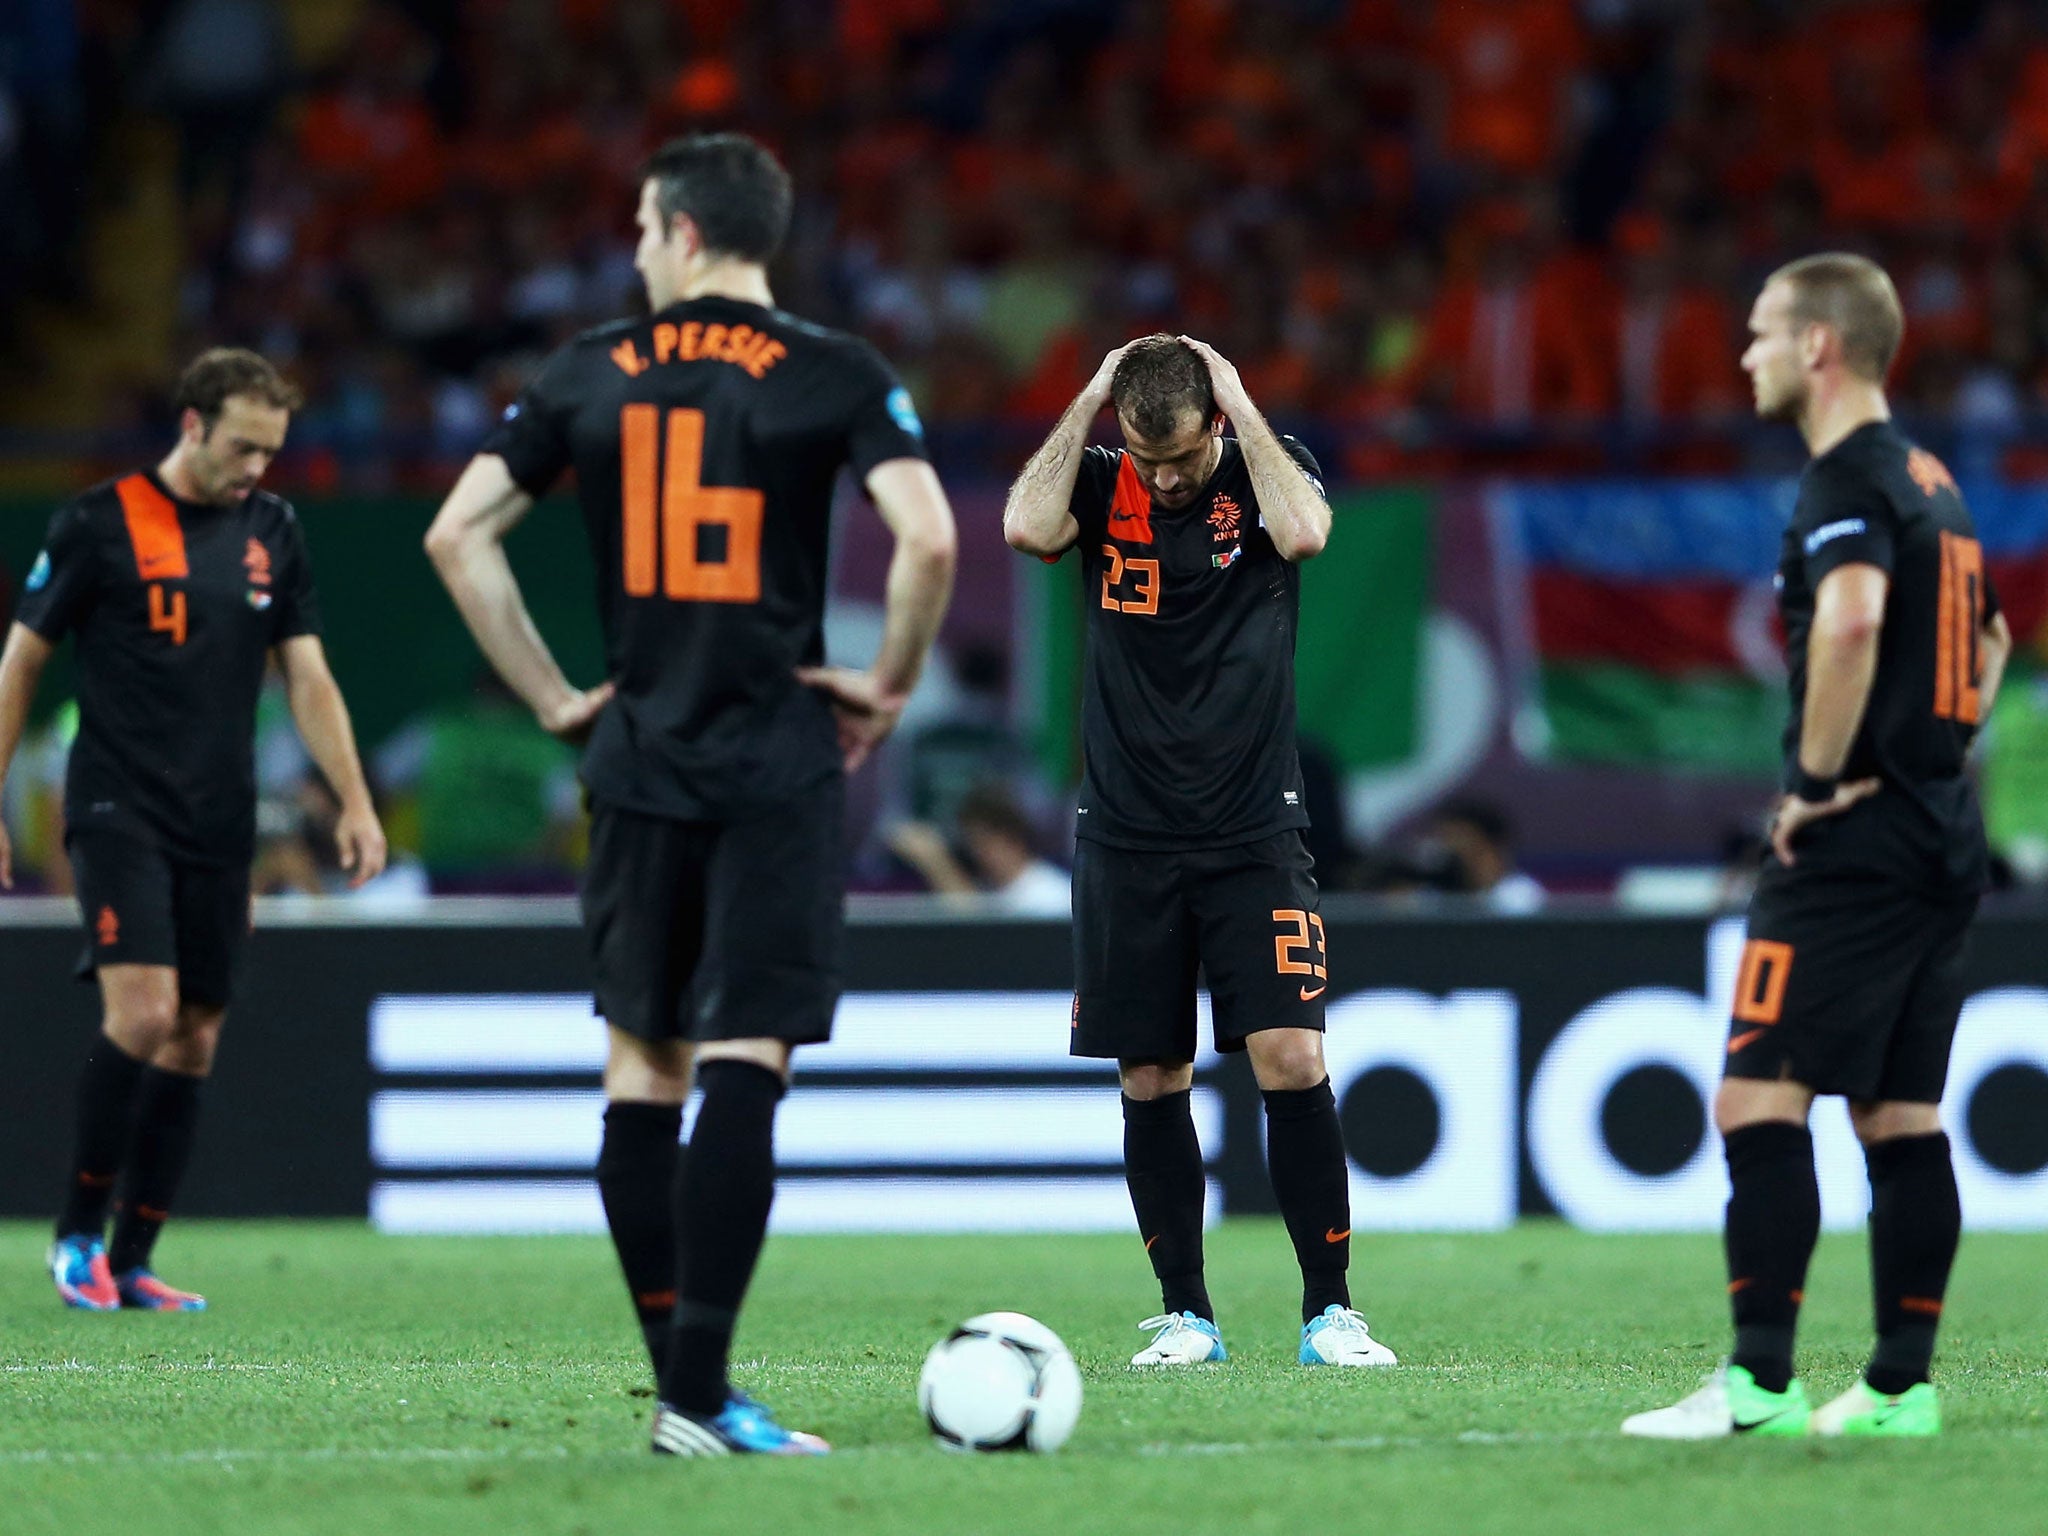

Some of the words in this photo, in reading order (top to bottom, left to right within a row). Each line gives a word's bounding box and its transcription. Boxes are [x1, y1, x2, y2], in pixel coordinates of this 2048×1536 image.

[652, 320, 788, 379] PERSIE
[620, 402, 765, 603] 16
[148, 582, 188, 646] 4
[1101, 543, 1162, 616] 23
[1933, 529, 1984, 726] 10
[1272, 908, 1327, 981] 23
